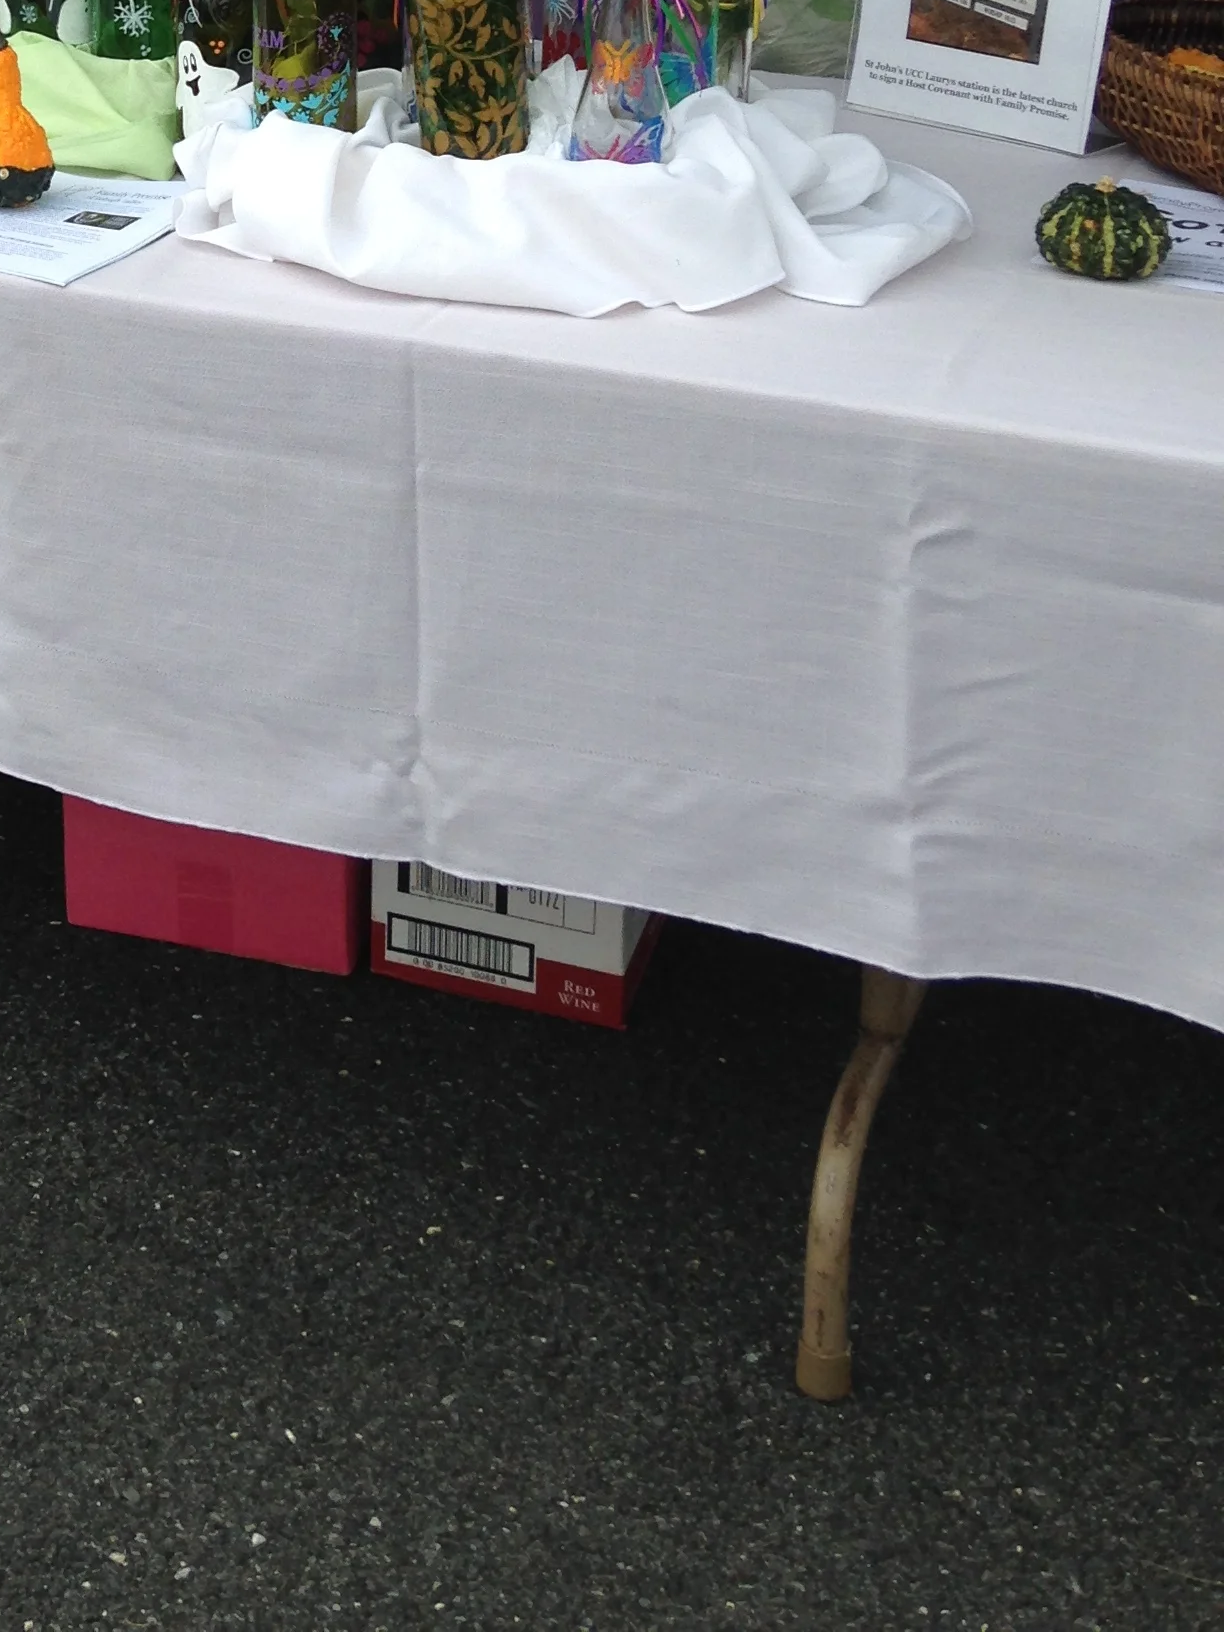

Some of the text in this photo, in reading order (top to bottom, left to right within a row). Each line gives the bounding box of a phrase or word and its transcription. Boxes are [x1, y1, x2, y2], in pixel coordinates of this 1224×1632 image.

[869, 71, 877, 80] to
[879, 73, 897, 85] sign
[898, 78, 904, 86] a
[905, 78, 926, 91] Host
[928, 83, 971, 100] Covenant
[972, 92, 993, 105] with
[995, 97, 1027, 113] Family
[905, 67, 923, 79] UCC
[992, 85, 1000, 95] is
[1002, 87, 1017, 99] the
[1019, 91, 1045, 105] latest
[1046, 97, 1078, 112] church
[557, 991, 601, 1013] WINE
[564, 979, 596, 997] RED
